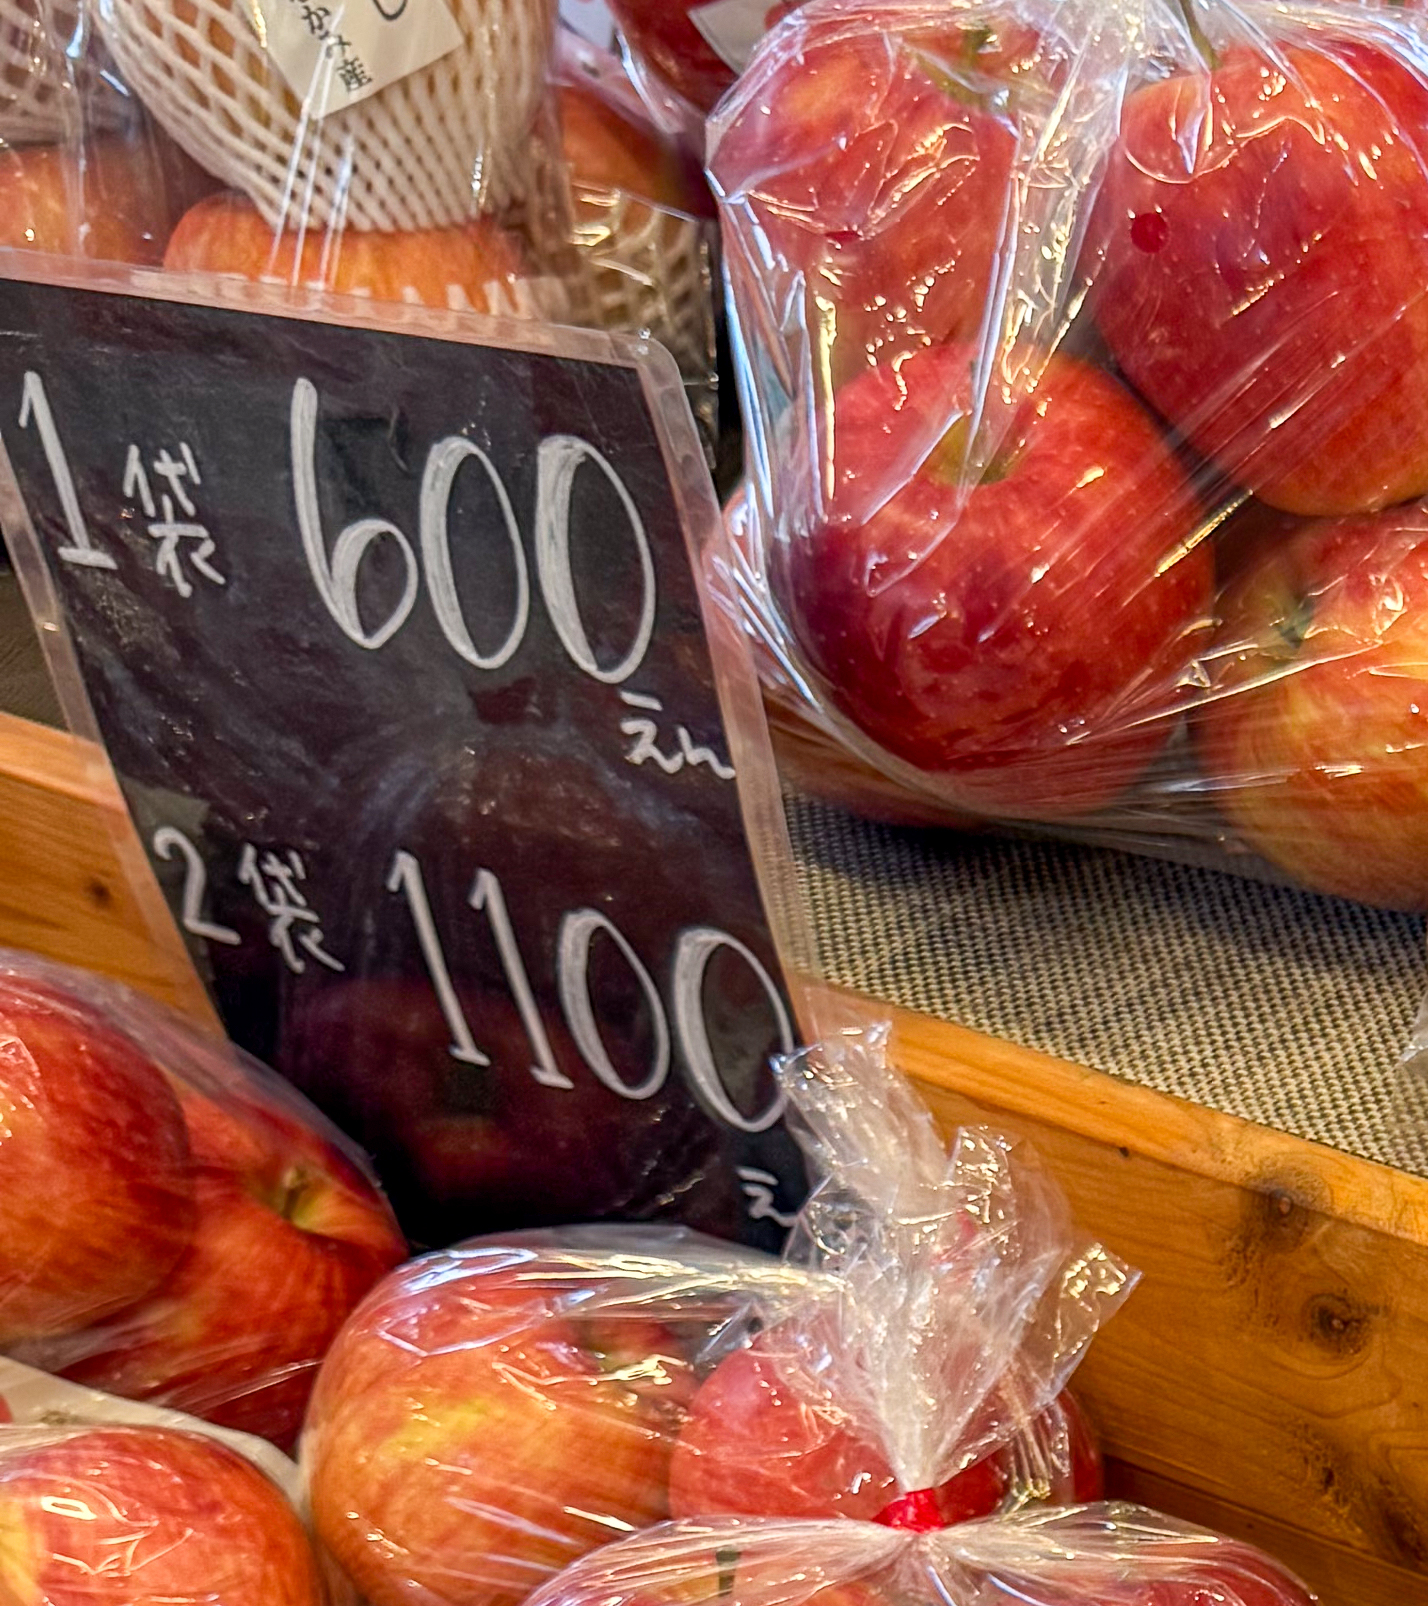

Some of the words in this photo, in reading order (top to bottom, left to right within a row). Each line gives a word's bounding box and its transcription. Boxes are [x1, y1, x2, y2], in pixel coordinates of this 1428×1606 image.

[19, 371, 225, 598] 1袋
[291, 378, 656, 684] 600
[621, 691, 735, 779] えん
[153, 826, 345, 973] 2袋
[388, 850, 796, 1133] 1100
